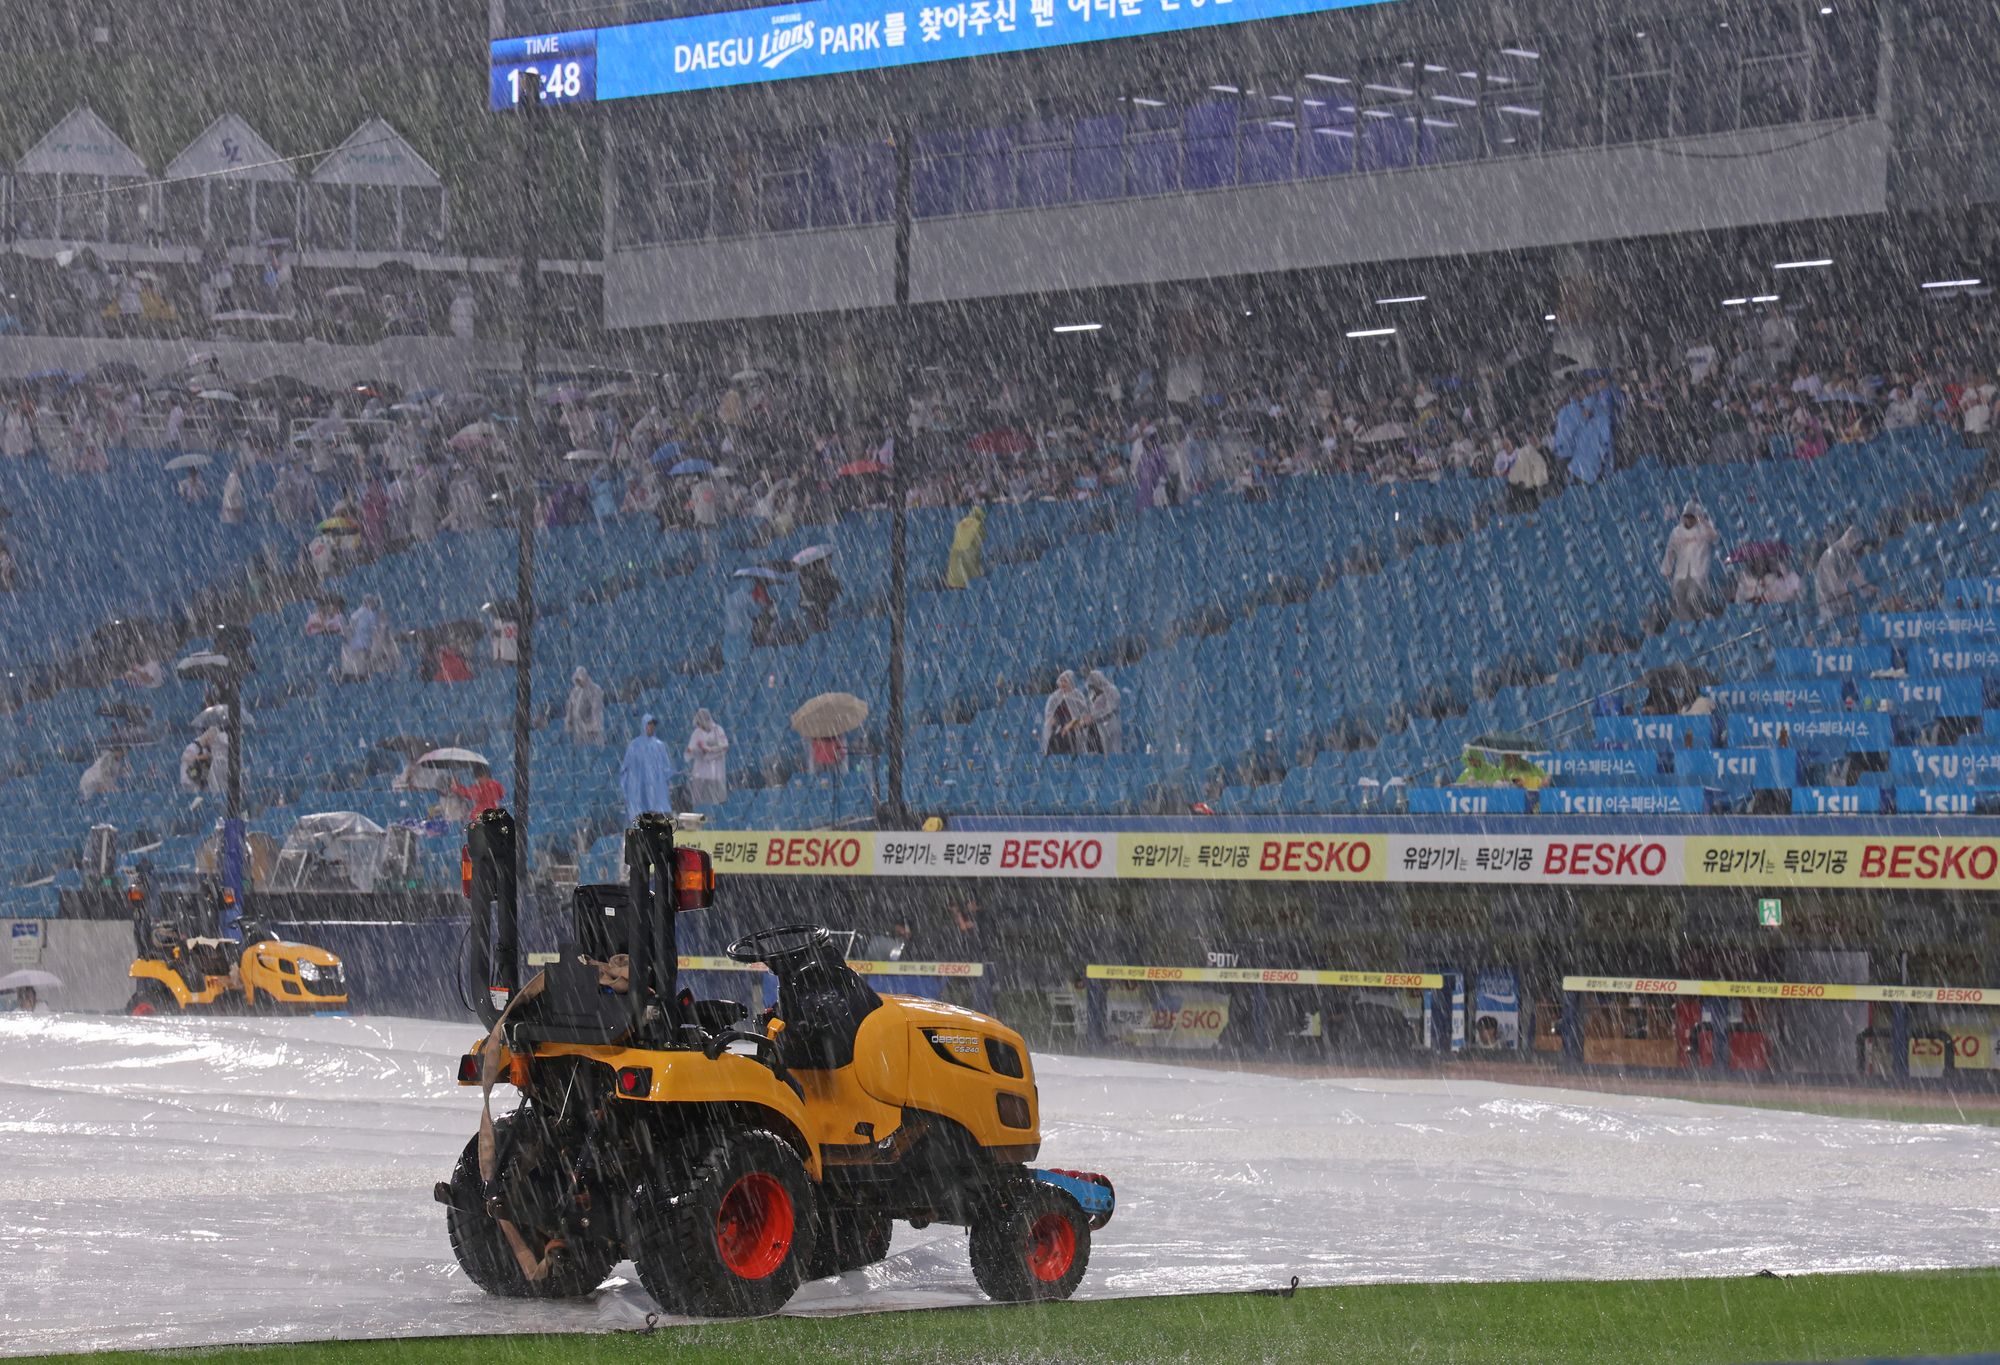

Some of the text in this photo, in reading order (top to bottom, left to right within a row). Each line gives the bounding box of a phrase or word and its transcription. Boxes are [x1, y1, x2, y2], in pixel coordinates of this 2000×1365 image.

[524, 36, 559, 55] TIME
[674, 36, 754, 73] DAEGU
[758, 20, 816, 68] Lions
[507, 61, 581, 103] 1:48
[713, 838, 860, 868] 득인기공 BESKO
[882, 839, 1103, 870] 유압기기는 득인기공 BESKO
[1131, 841, 1371, 873] 유압기기는 득인기공 BESKO
[1402, 843, 1667, 876] 유압기기는 득인기공 BESKO
[1702, 844, 1999, 881] 유압기기는 득인기공 BESKO
[937, 963, 971, 975] BESKO
[1147, 968, 1183, 980] BESKO
[1262, 970, 1298, 982] BESKO
[1384, 974, 1423, 986] BESKO
[1635, 980, 1678, 992] BESKO
[1781, 984, 1825, 997] BESKO
[1936, 989, 1983, 1002] BESKO
